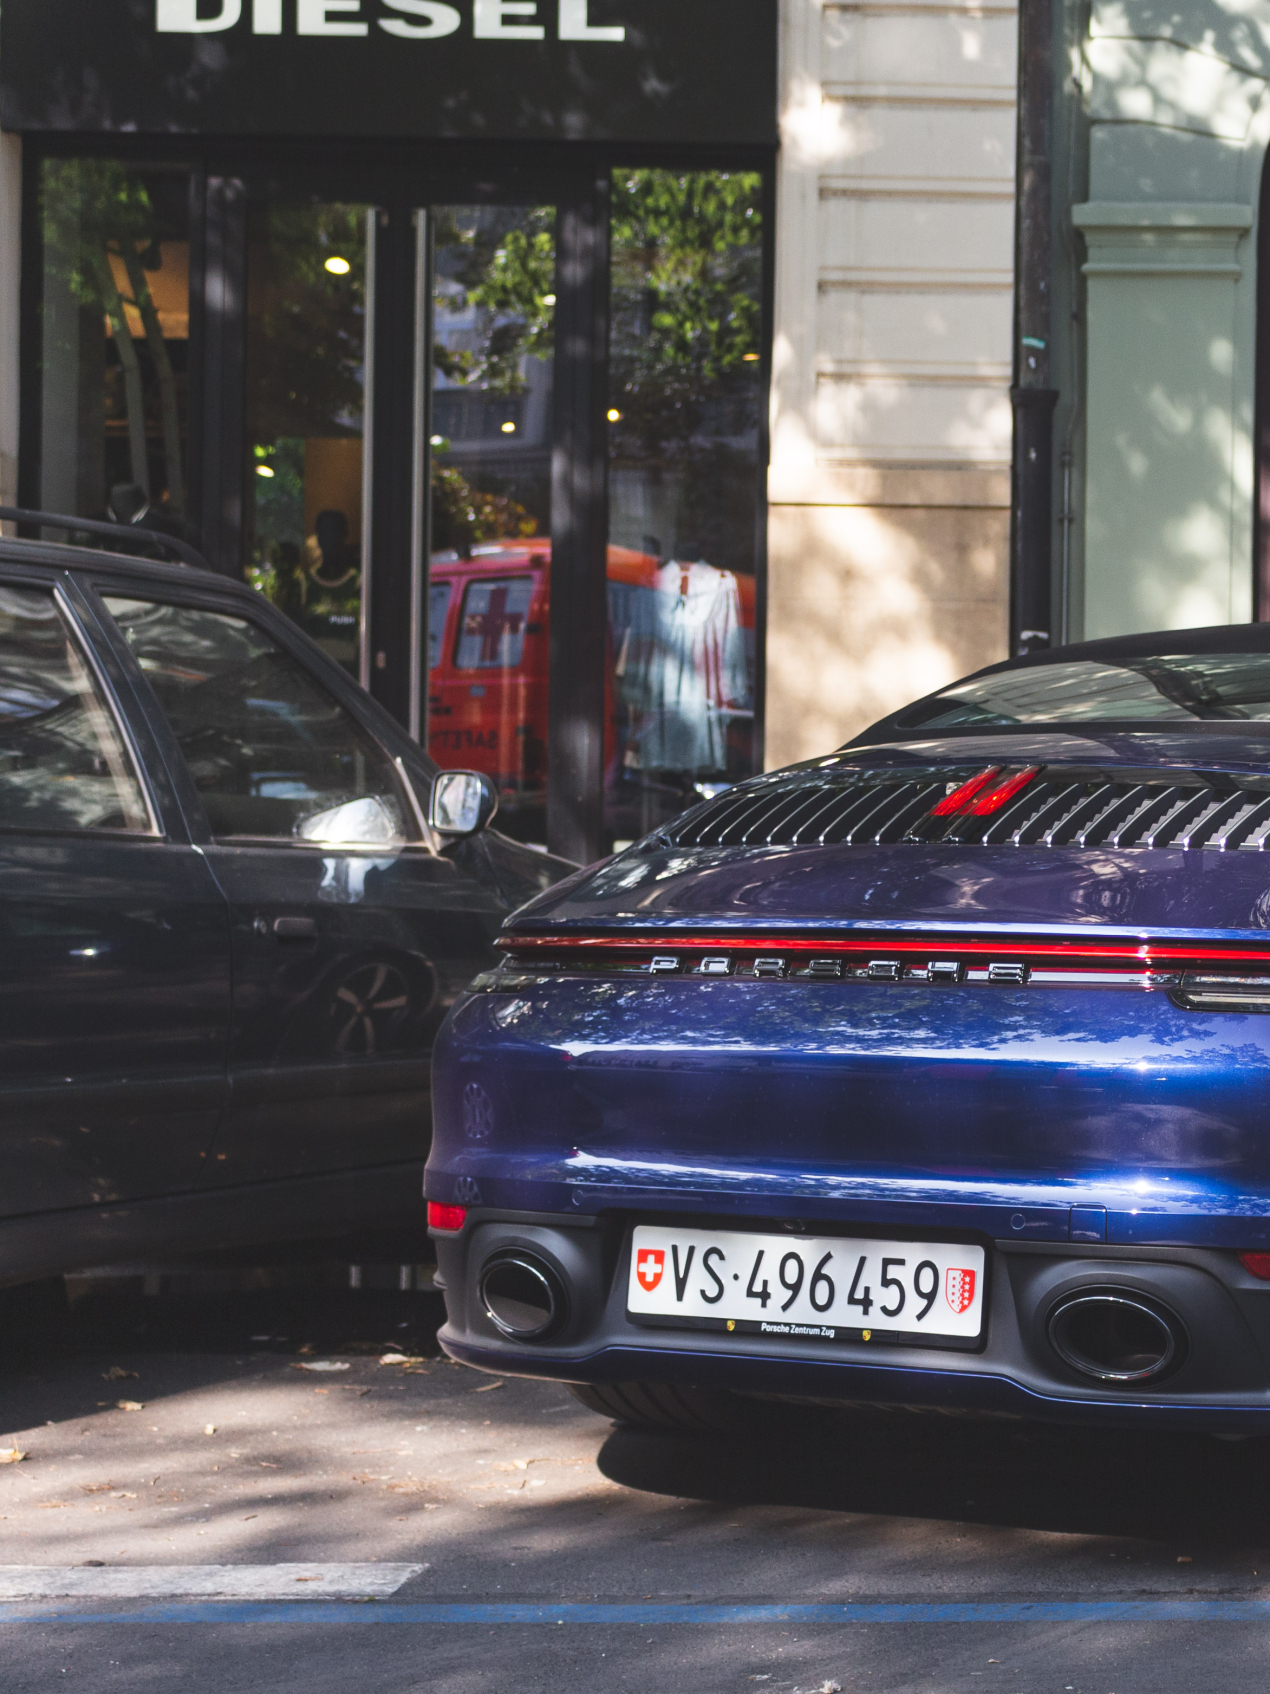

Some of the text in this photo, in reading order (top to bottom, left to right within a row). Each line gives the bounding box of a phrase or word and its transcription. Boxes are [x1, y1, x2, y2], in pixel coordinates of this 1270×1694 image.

[155, 0, 626, 41] DIESEL
[329, 615, 356, 625] PUSH
[650, 957, 1024, 983] PORSCHE
[761, 1322, 835, 1339] Porsche Zentrum Zug
